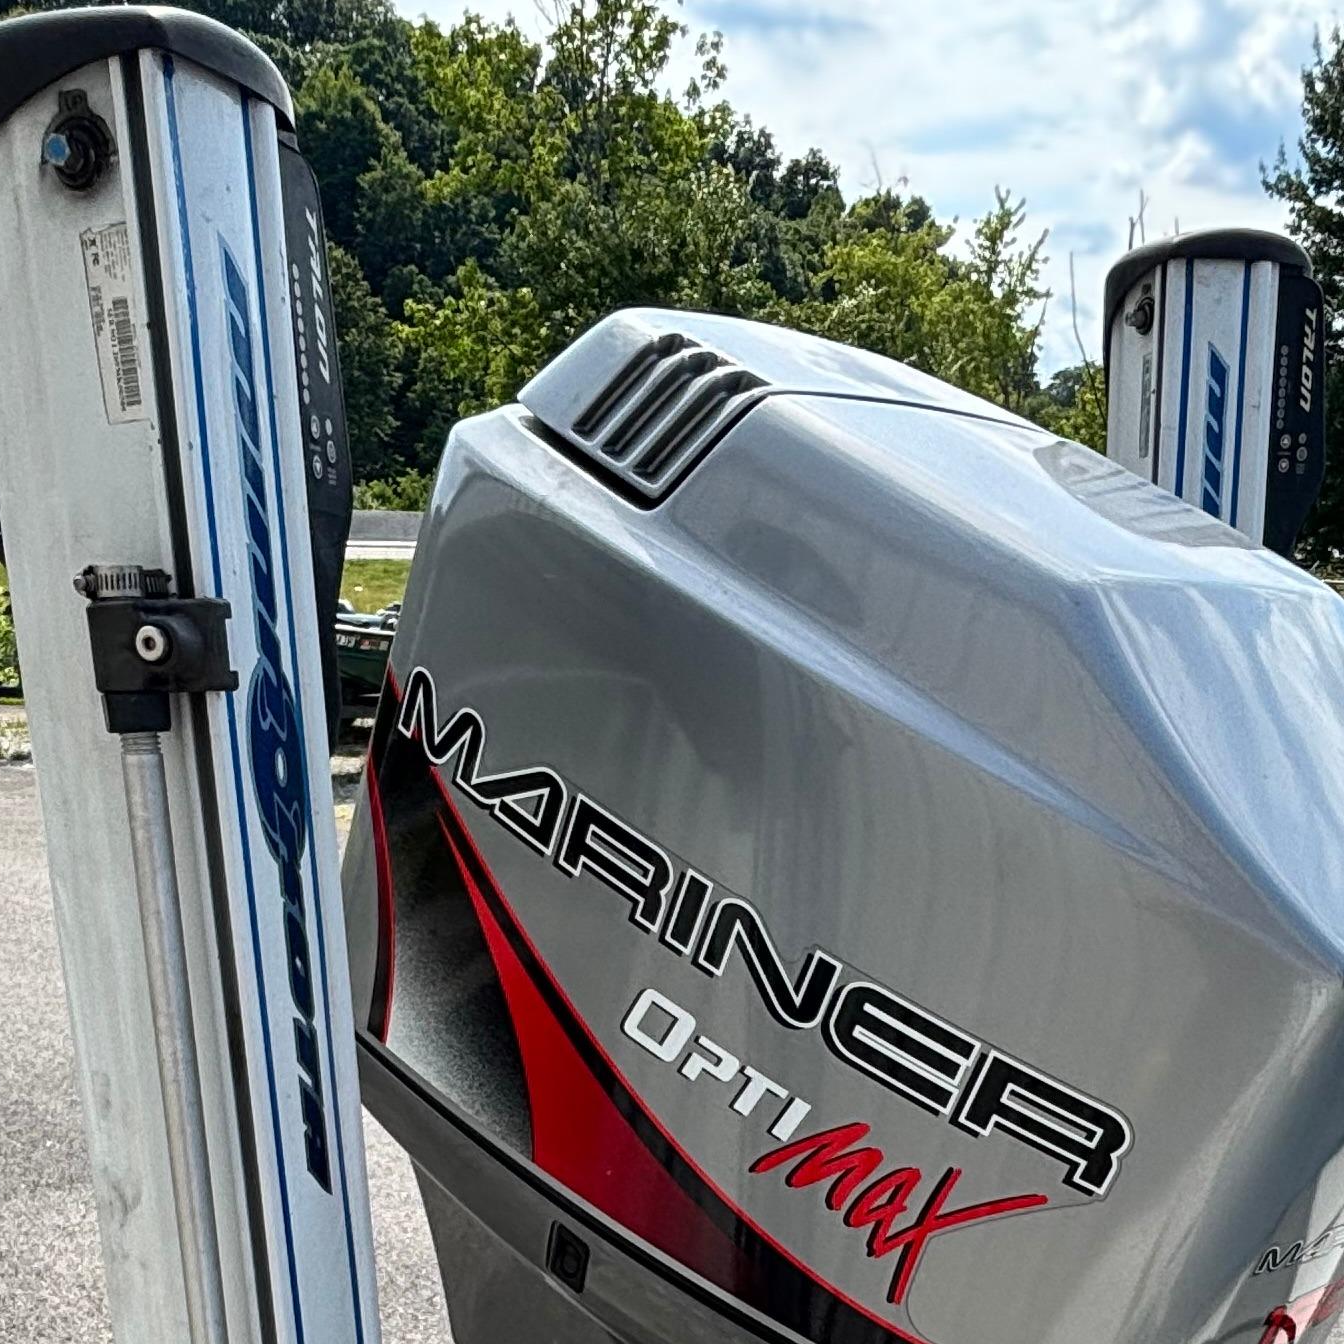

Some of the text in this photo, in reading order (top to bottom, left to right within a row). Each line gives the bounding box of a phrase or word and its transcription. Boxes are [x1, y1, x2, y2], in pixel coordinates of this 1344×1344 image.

[304, 207, 331, 384] TALON
[1299, 307, 1318, 412] TALON
[398, 667, 1134, 1196] MARINER
